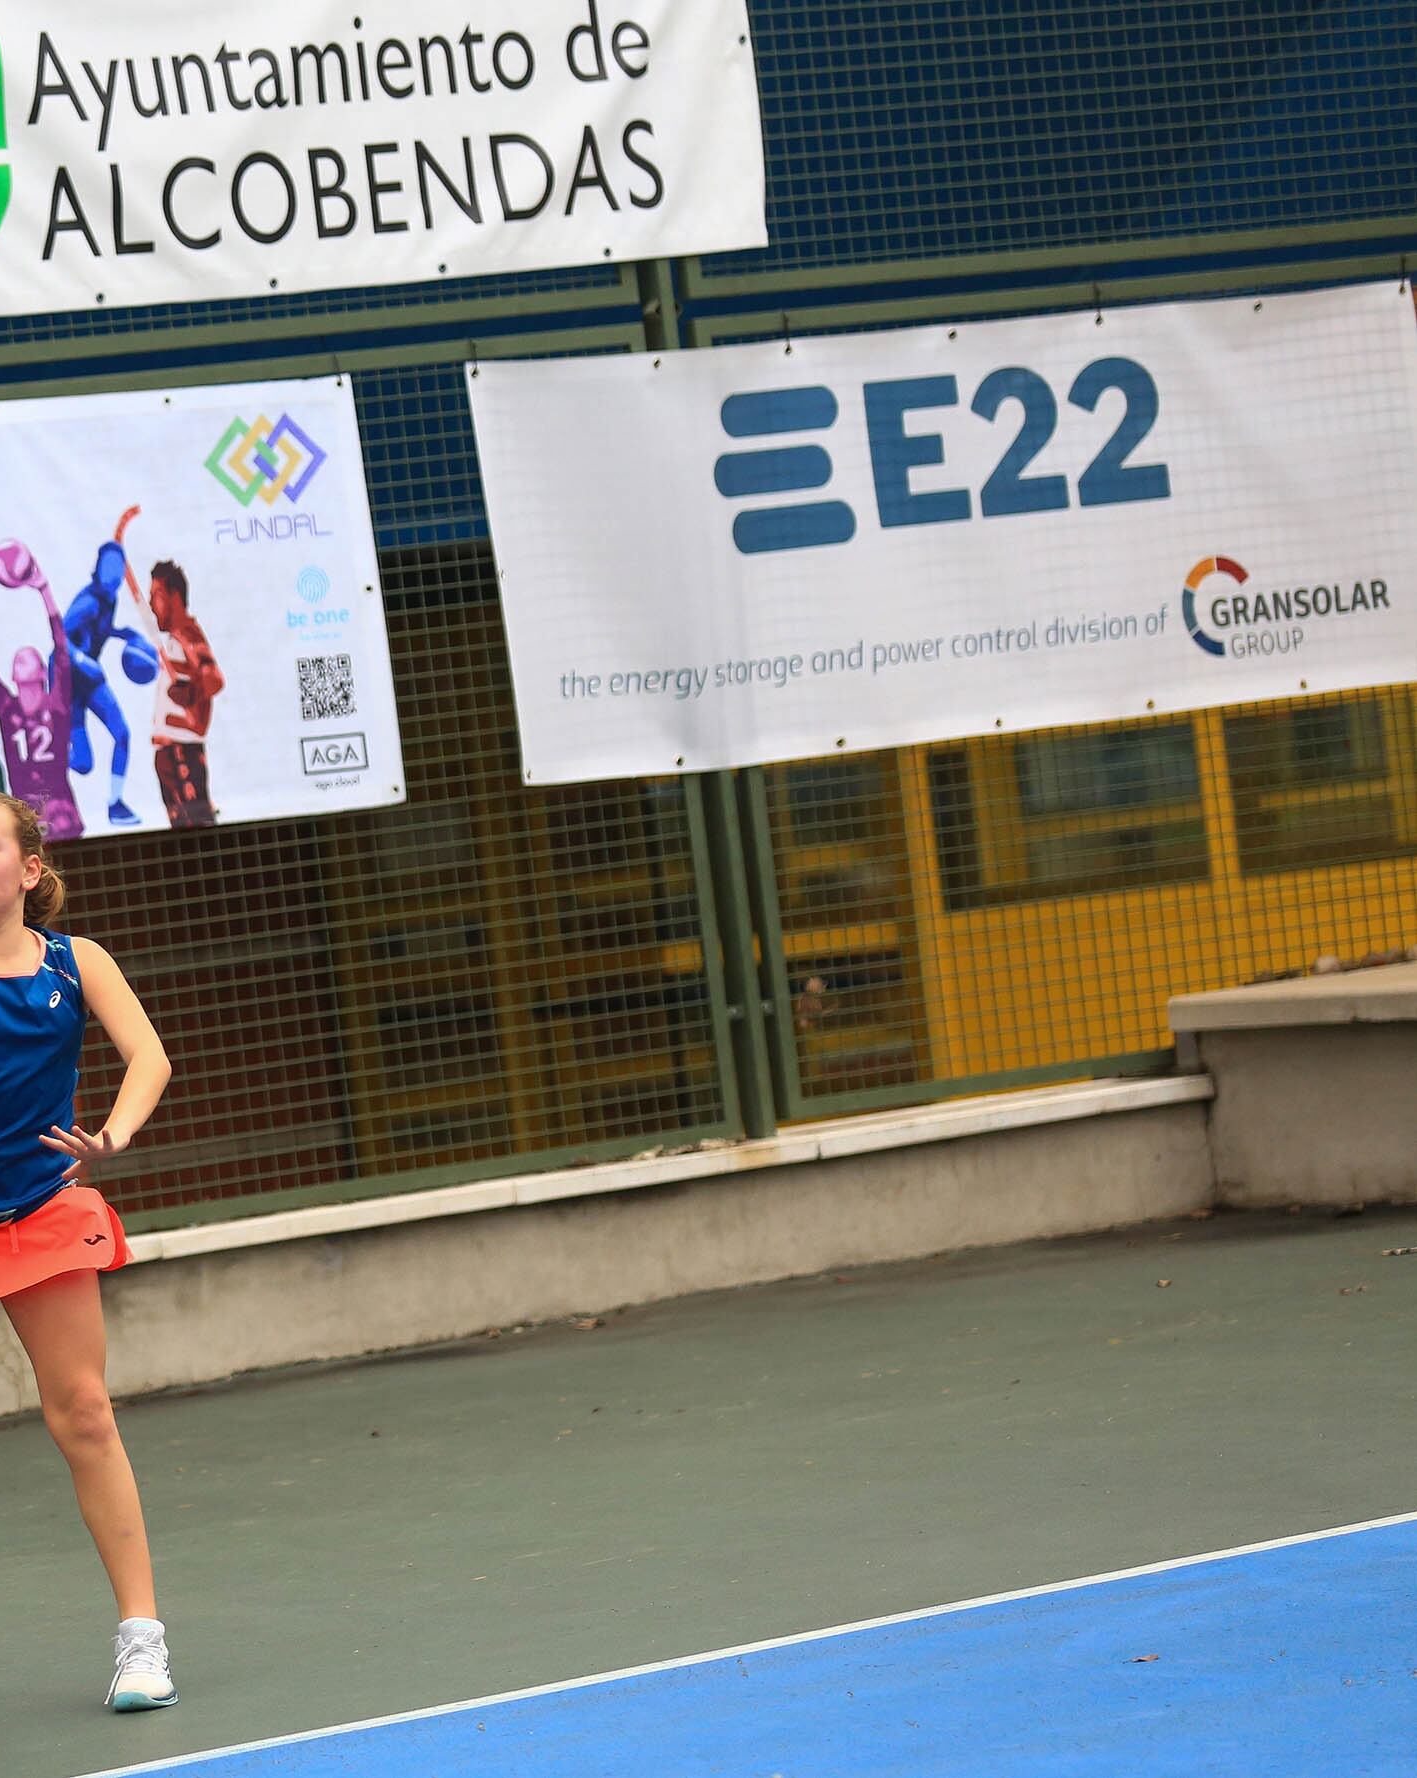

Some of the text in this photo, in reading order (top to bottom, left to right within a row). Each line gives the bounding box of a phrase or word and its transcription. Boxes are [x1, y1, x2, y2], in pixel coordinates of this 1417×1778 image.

[27, 0, 650, 151] Ayuntamiento de
[40, 119, 664, 260] ALCOBENDAS
[863, 356, 1171, 529] E22
[214, 513, 332, 545] FUNDAL
[286, 608, 350, 628] be one
[1210, 578, 1390, 628] GRANSOLAR
[560, 606, 1168, 700] the energy storage and power control division of
[1230, 628, 1305, 660] GROUP
[11, 725, 55, 762] 12
[311, 743, 359, 766] AGA
